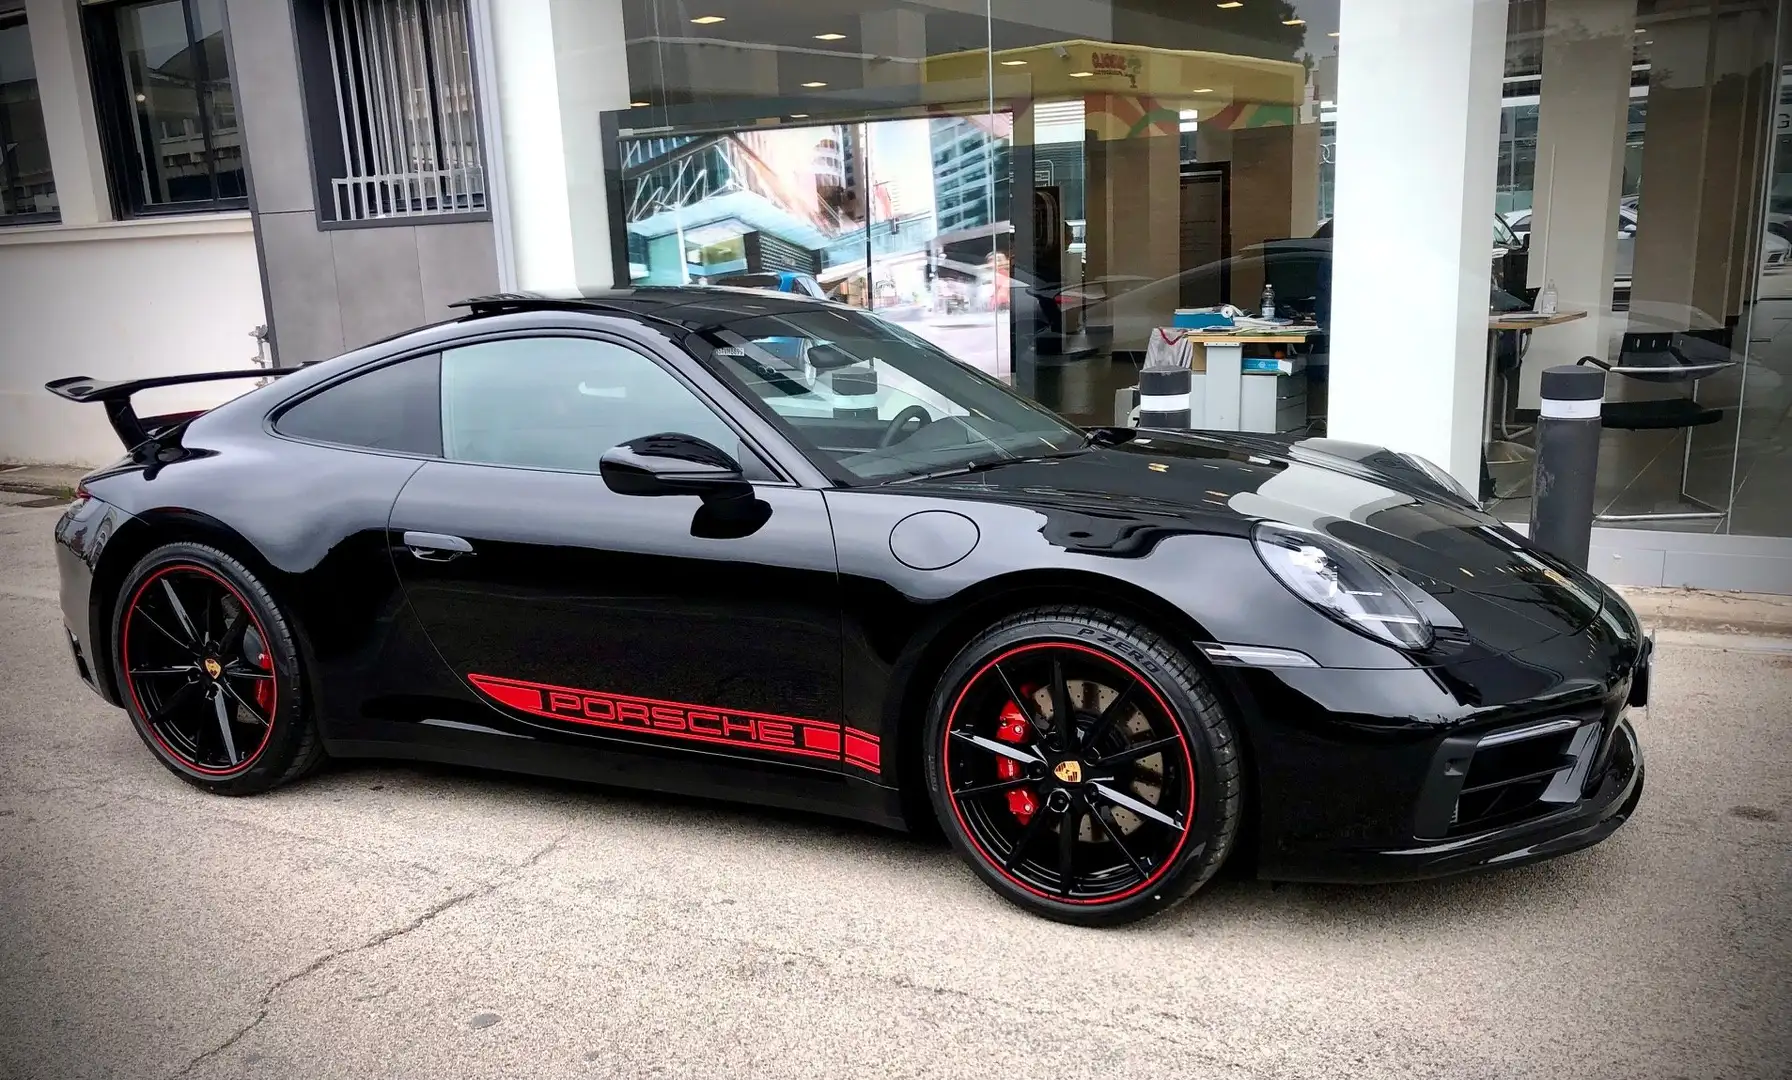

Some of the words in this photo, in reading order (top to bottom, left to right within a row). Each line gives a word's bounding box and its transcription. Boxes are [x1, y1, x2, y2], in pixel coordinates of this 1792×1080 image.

[1077, 628, 1095, 636] P
[1097, 634, 1161, 673] ZERO
[550, 692, 795, 745] PORSCHE
